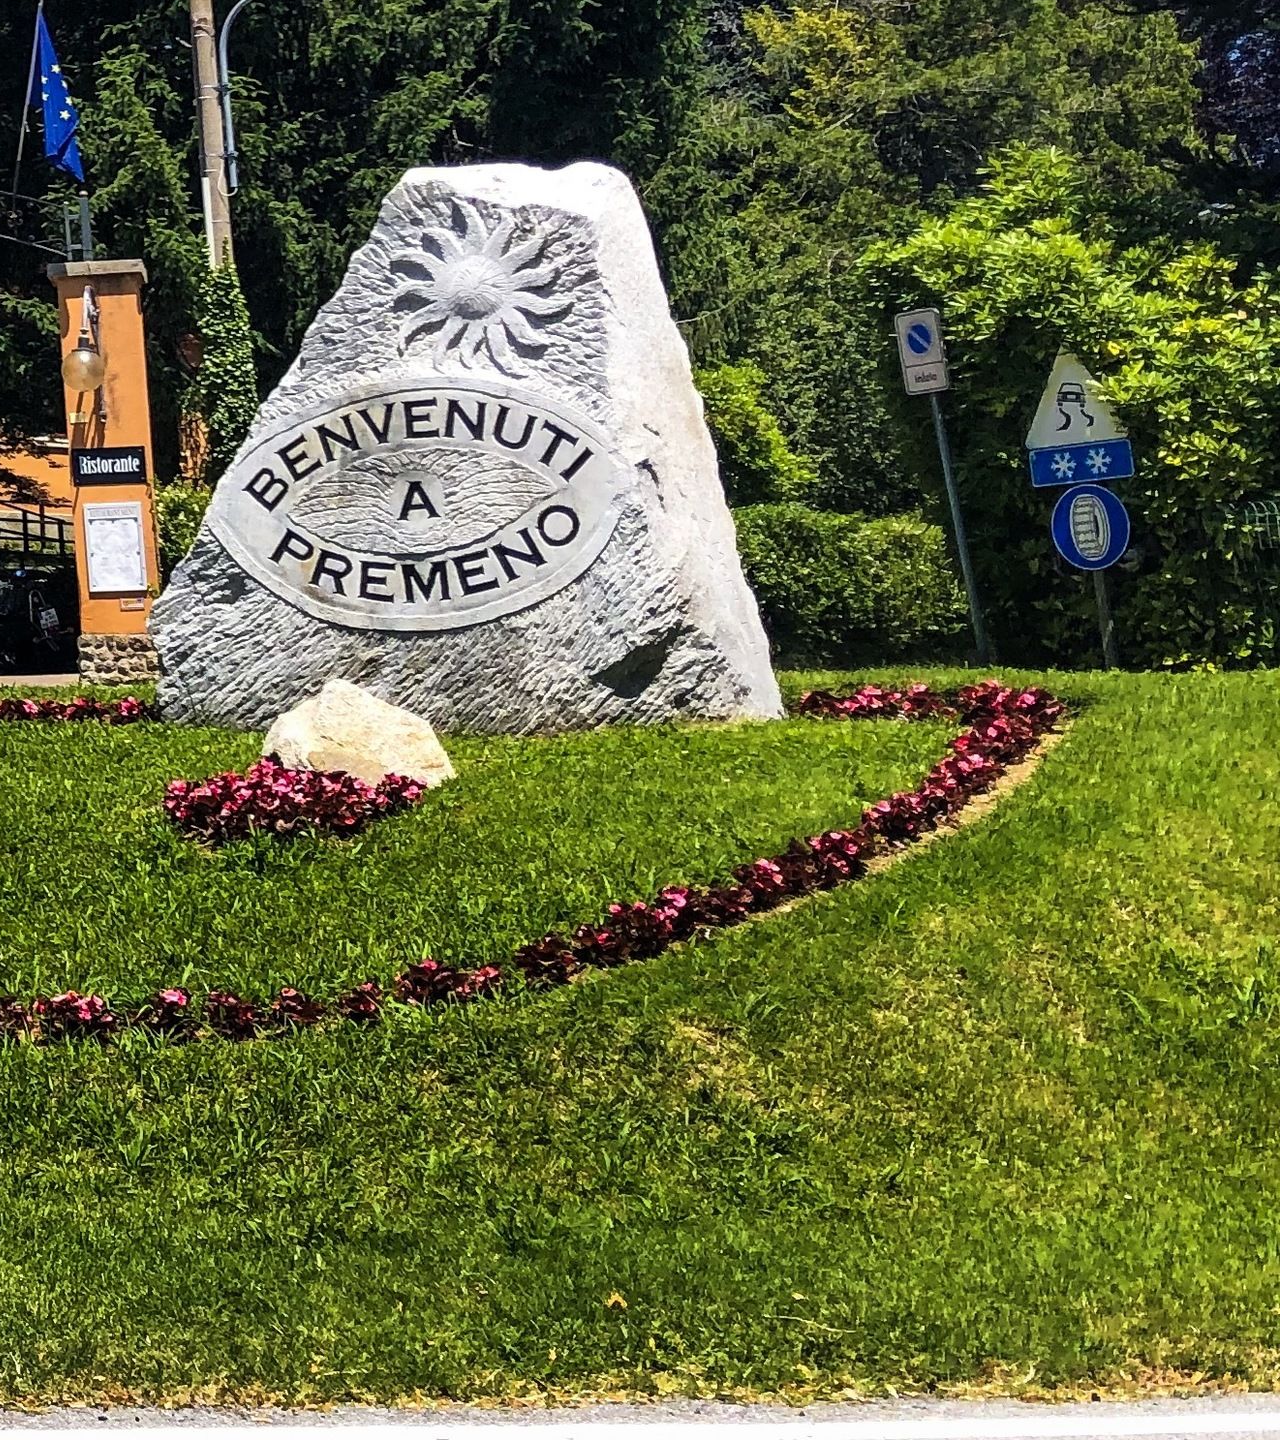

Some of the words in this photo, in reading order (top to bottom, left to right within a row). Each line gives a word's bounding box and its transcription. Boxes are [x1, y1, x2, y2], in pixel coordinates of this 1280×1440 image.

[78, 455, 141, 475] Ristorante
[243, 398, 594, 512] BENVENUTI
[397, 481, 441, 521] A
[269, 504, 580, 604] PREMENO
